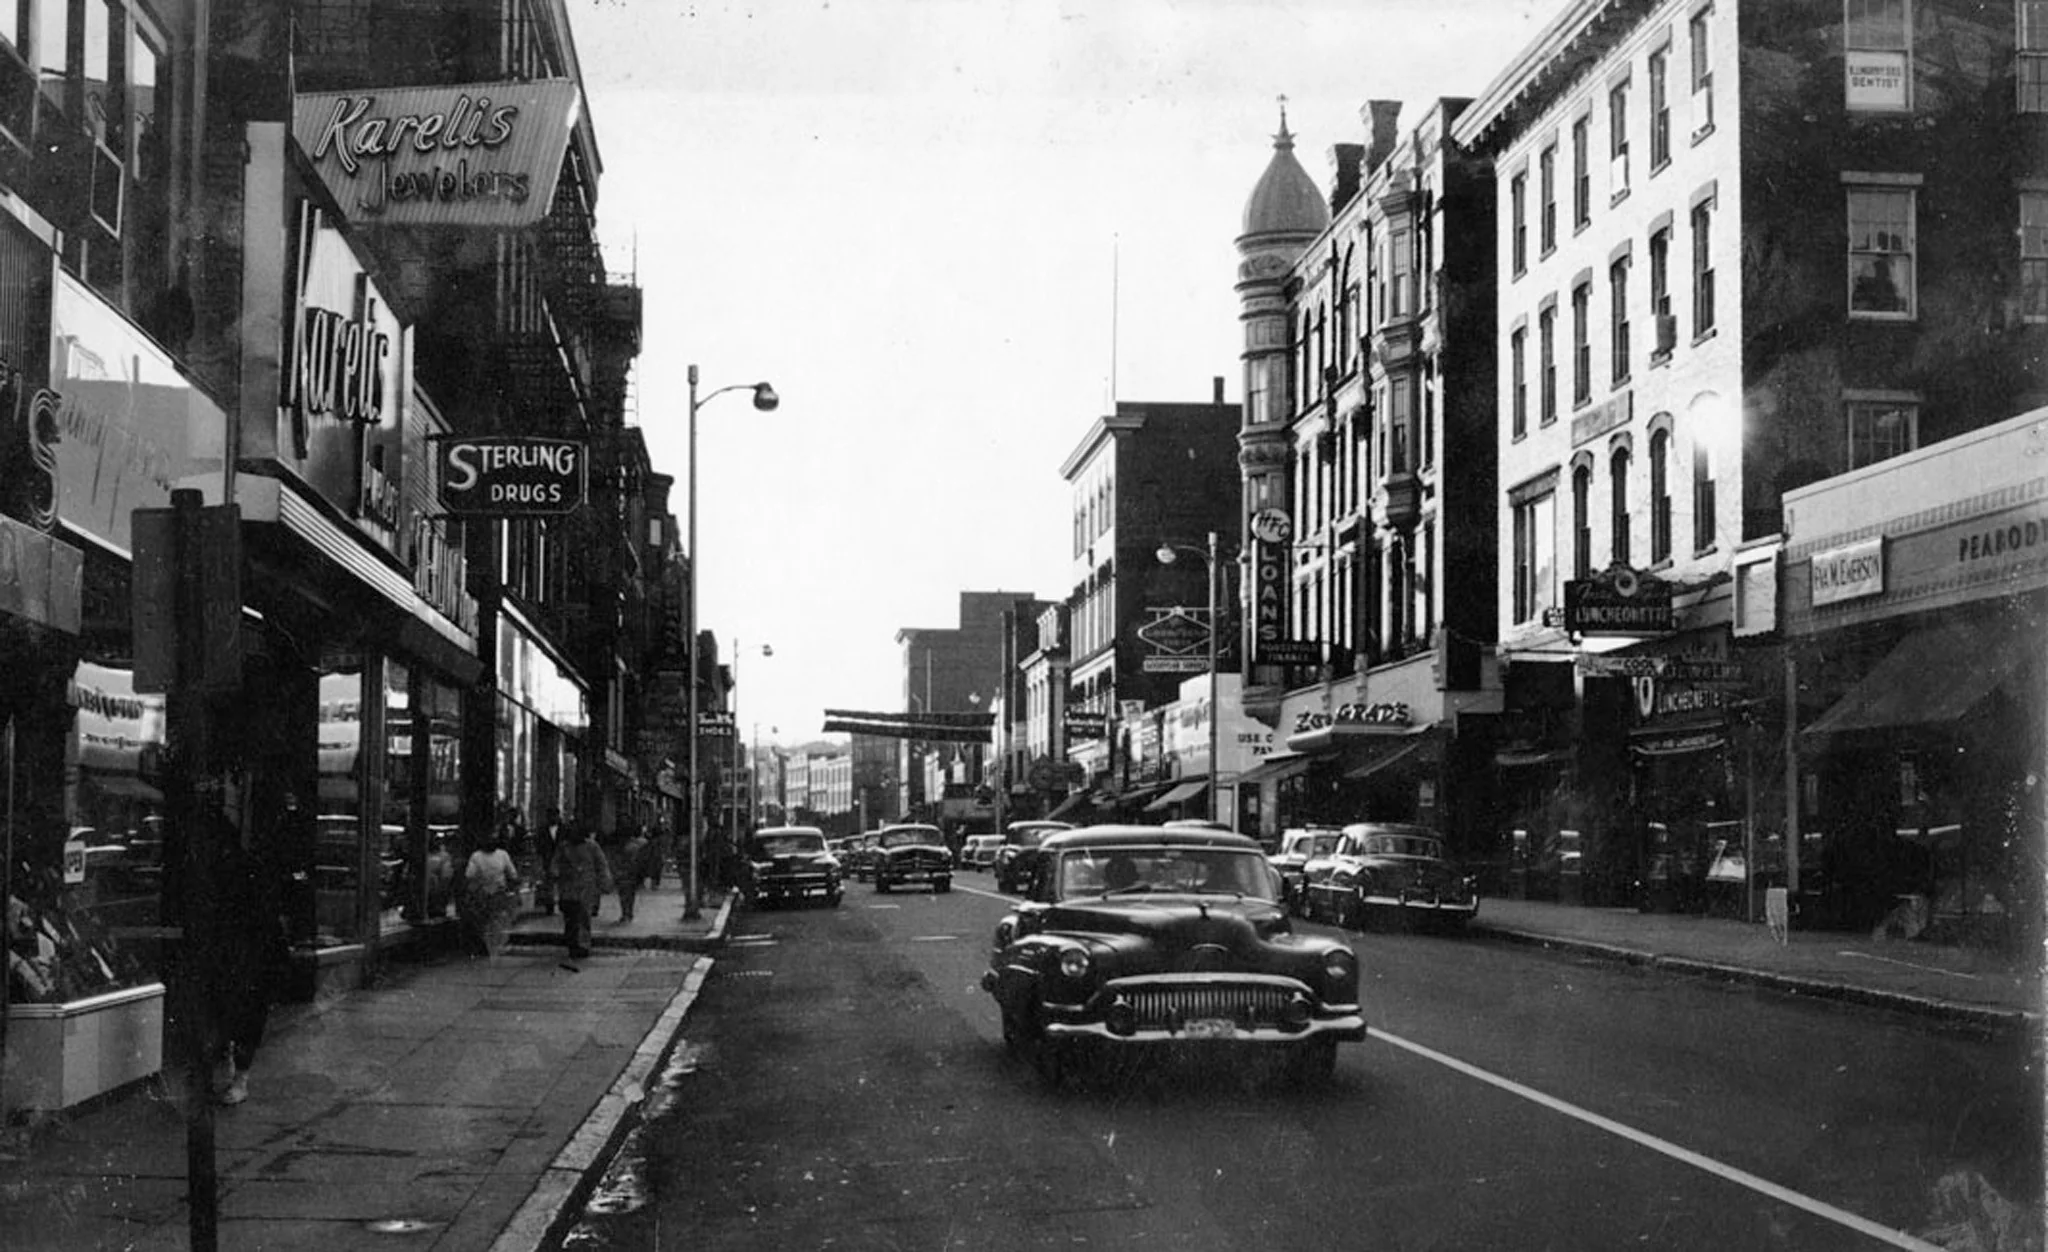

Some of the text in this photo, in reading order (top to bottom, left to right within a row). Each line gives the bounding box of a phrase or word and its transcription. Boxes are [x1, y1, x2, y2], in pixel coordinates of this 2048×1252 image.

[1852, 76, 1899, 88] DENTIST
[314, 92, 518, 178] Karelis
[357, 158, 530, 215] Jewelers
[447, 443, 576, 491] STERLING
[491, 484, 562, 502] DRUGS
[1257, 511, 1291, 538] HFC
[1260, 546, 1278, 640] LOANS
